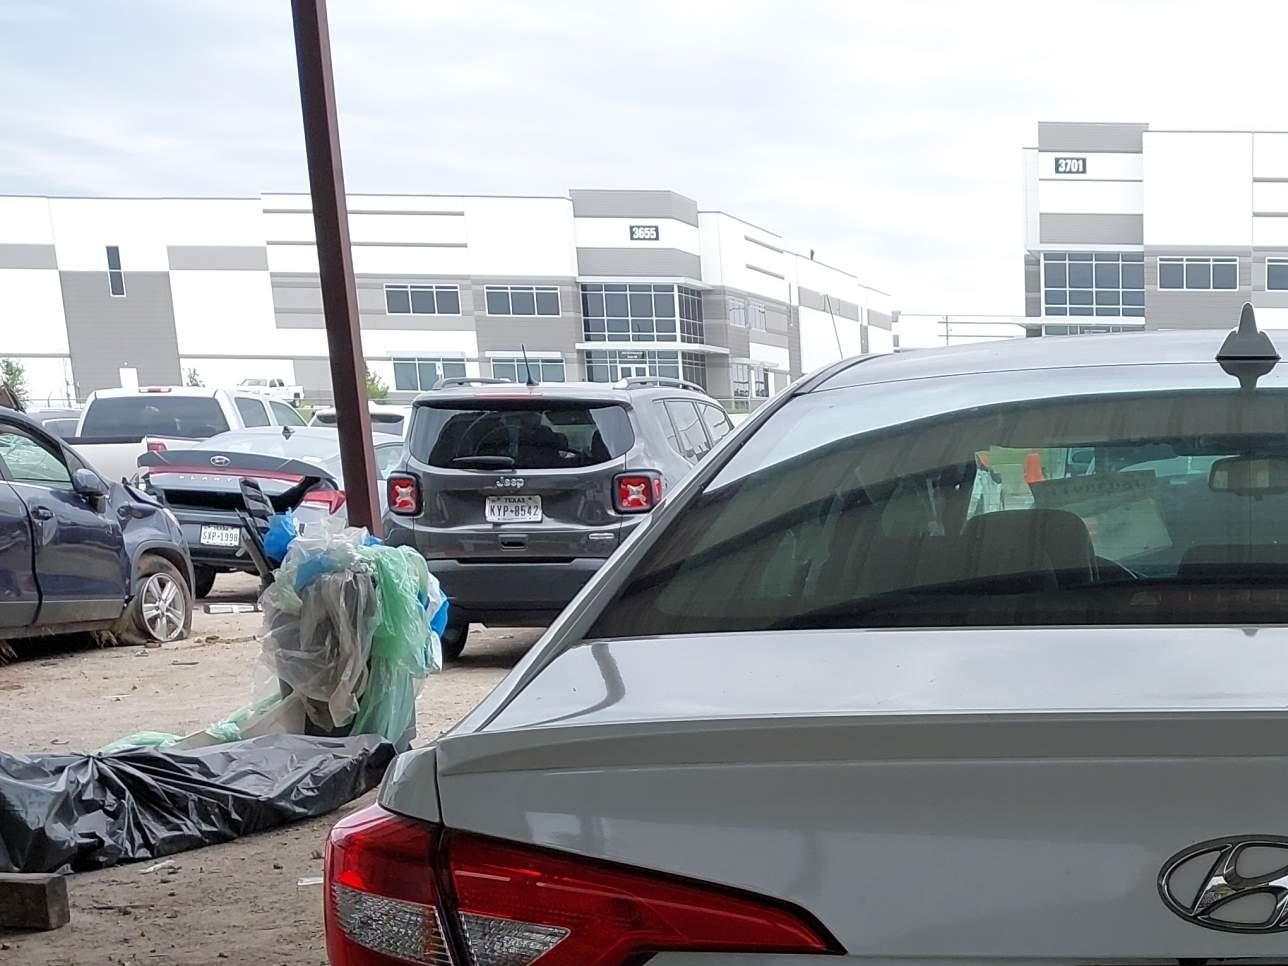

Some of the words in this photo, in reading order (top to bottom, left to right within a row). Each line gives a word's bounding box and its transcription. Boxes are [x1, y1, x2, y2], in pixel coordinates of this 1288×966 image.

[1058, 159, 1083, 172] 3701
[632, 227, 657, 239] 3655
[496, 476, 525, 488] Jeep
